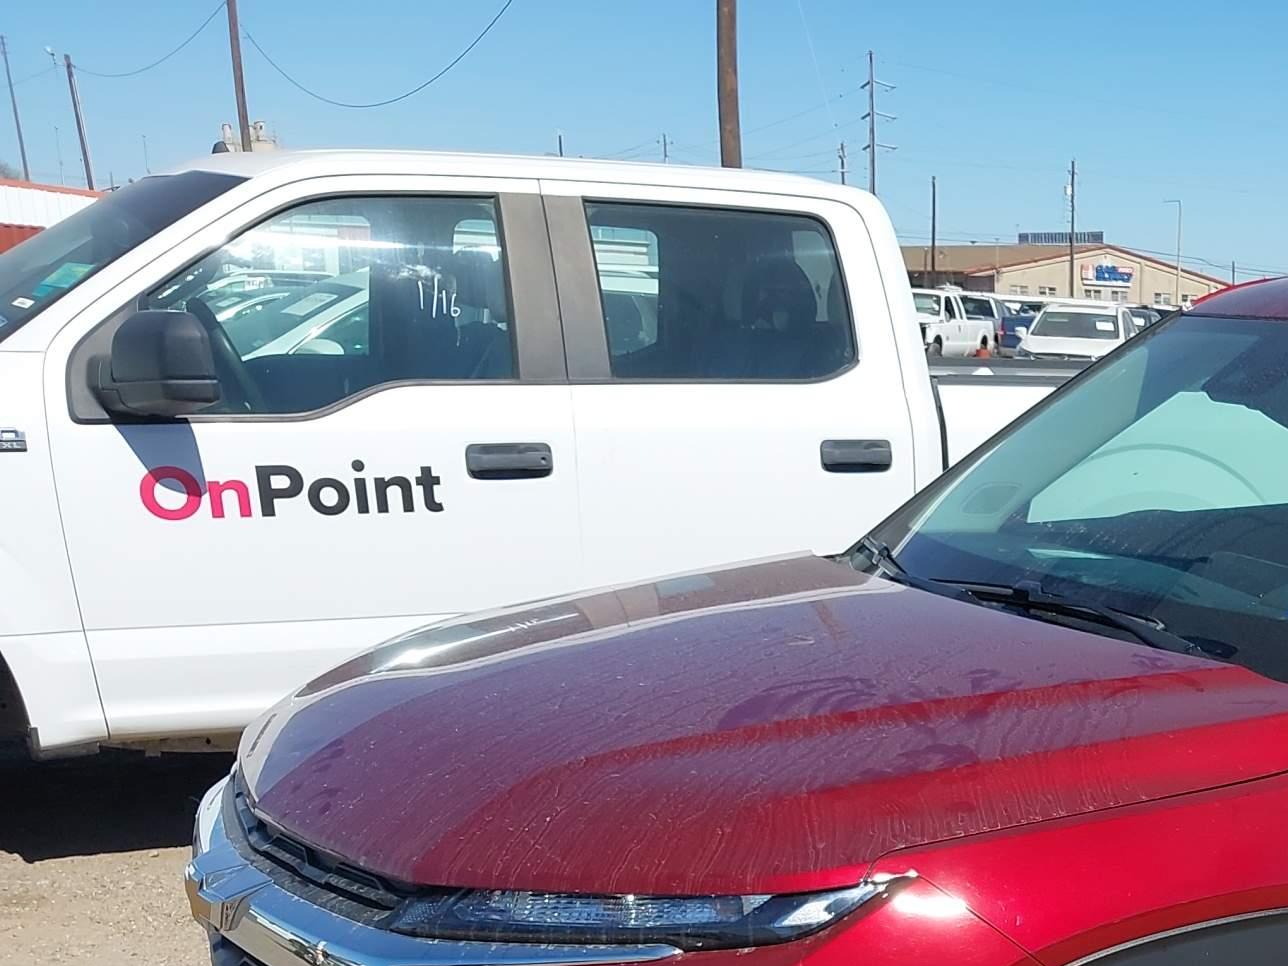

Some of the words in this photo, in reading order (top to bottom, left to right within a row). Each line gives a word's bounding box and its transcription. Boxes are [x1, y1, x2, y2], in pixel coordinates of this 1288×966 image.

[417, 273, 461, 318] 1/16
[2, 441, 22, 449] XL
[140, 459, 444, 521] OnPoint
